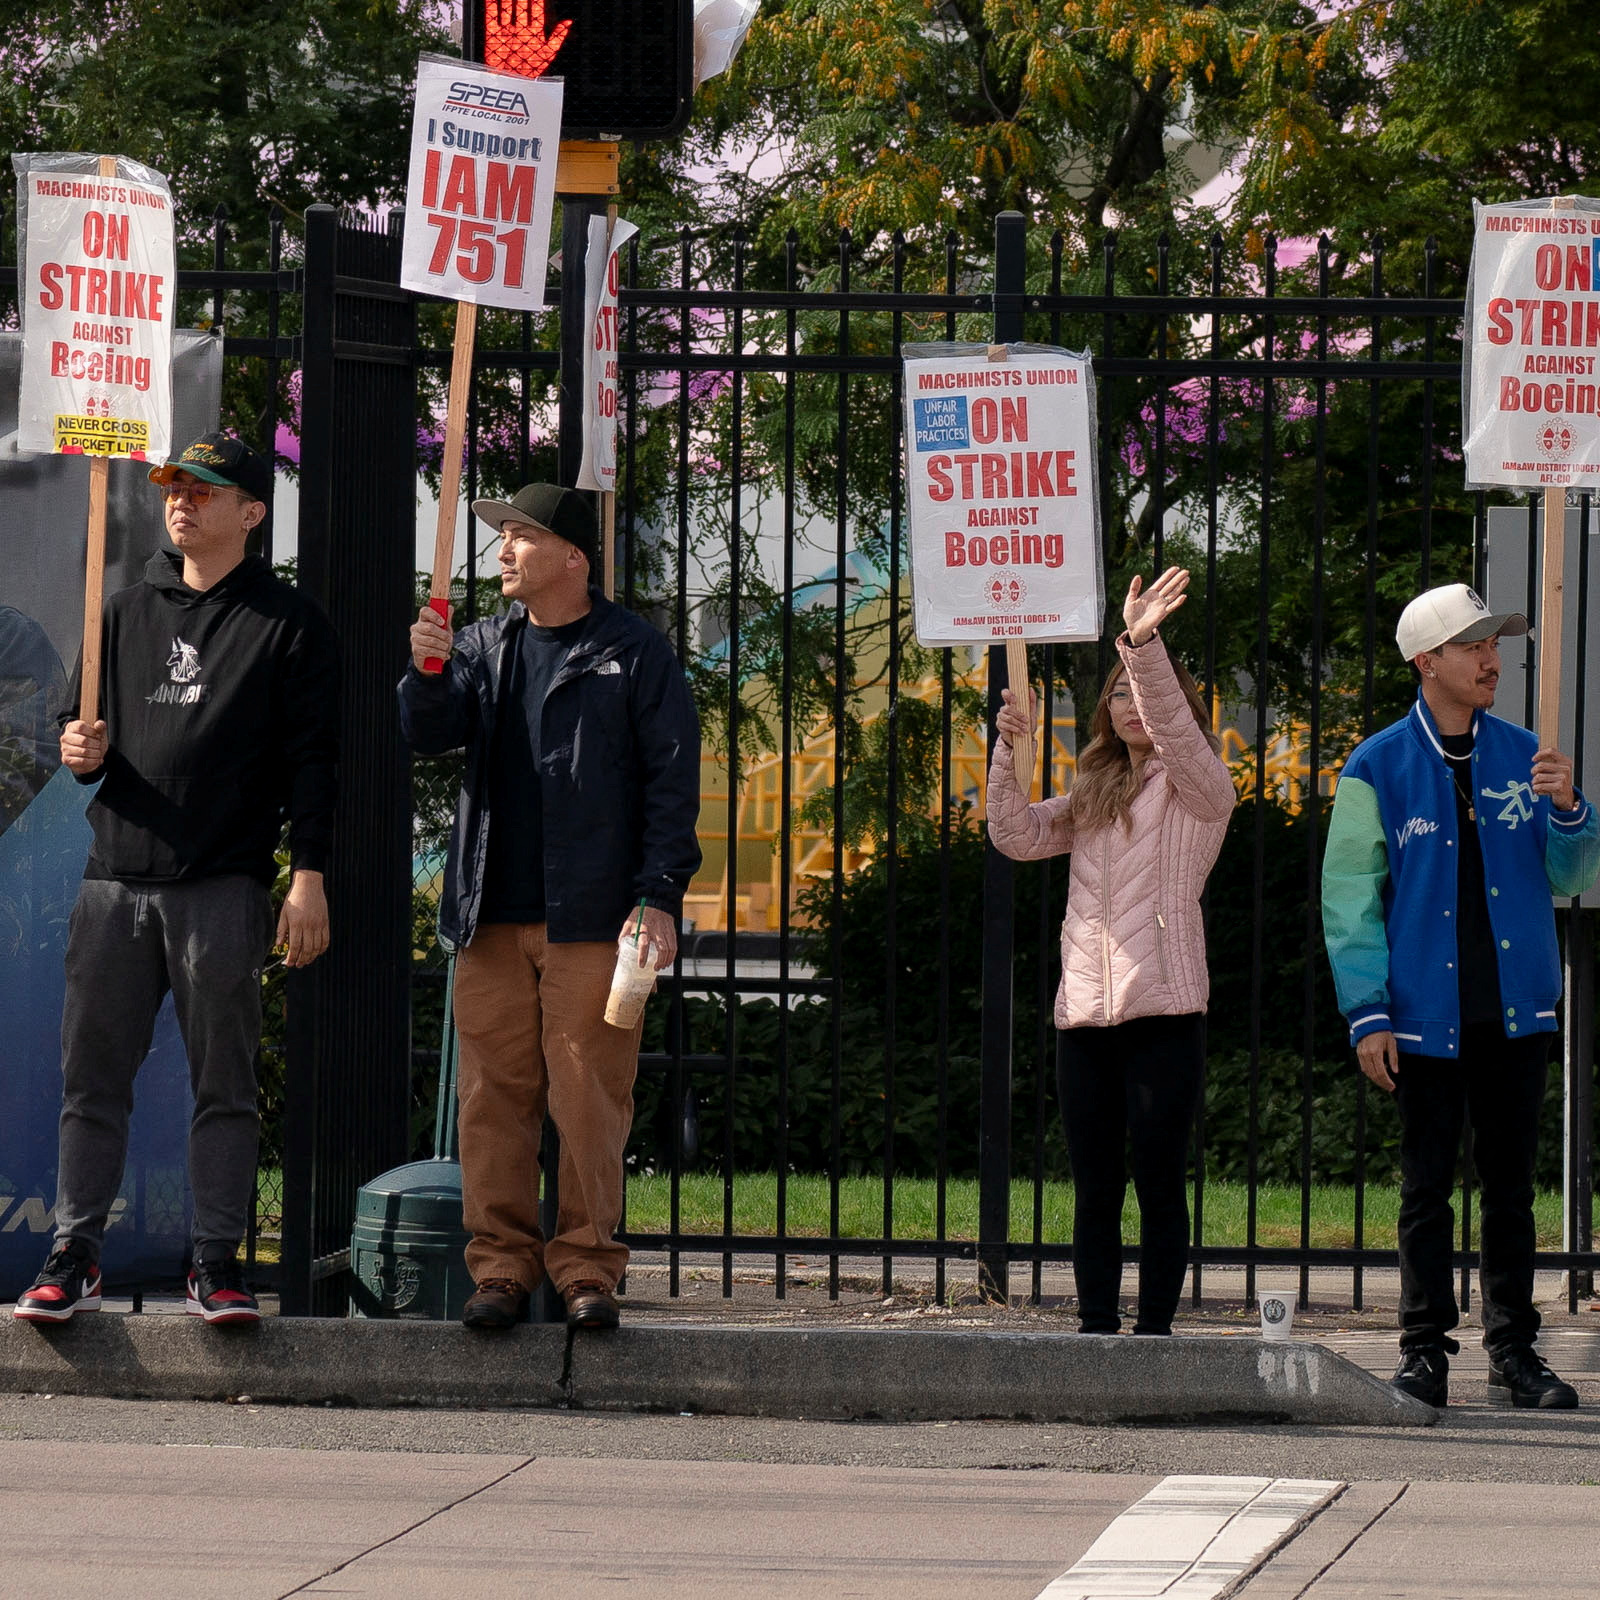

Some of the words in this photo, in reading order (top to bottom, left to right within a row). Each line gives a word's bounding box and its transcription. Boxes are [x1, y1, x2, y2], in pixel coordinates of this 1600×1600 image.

[446, 81, 531, 118] SPEEA
[442, 103, 470, 116] IFPTE
[471, 108, 503, 122] LOCAL
[505, 115, 530, 126] 2001
[427, 118, 436, 144] I
[442, 121, 542, 161] Support
[36, 180, 127, 203] MACHINISTS
[130, 189, 165, 210] UNION
[83, 211, 130, 261] ON
[1485, 216, 1587, 234] MACHINISTS
[427, 213, 528, 289] 751
[1535, 243, 1590, 291] ON
[40, 262, 164, 322] STRIKE
[72, 321, 133, 346] AGAINST
[51, 341, 151, 391] Boeing
[1524, 355, 1596, 375] AGAINST
[918, 370, 1022, 390] MACHINISTS
[1026, 369, 1078, 386] UNION
[924, 400, 958, 414] UNFAIR
[58, 417, 100, 431] NEVER
[102, 420, 147, 435] CROSS
[926, 414, 957, 428] LABOR
[971, 397, 1028, 444] ON
[58, 437, 67, 448] A
[71, 437, 115, 452] PICKET
[917, 428, 968, 443] PRACTICES!
[927, 450, 1077, 501] STRIKE
[1536, 462, 1571, 473] DISTRICT
[1540, 474, 1571, 483] AFL-CIO
[967, 507, 1039, 527] AGAINST
[945, 529, 1064, 568] Boeing
[987, 614, 1022, 625] DISTRICT
[1023, 614, 1047, 624] LODGE
[1048, 613, 1061, 623] 751
[991, 625, 1023, 636] AFL-CIO
